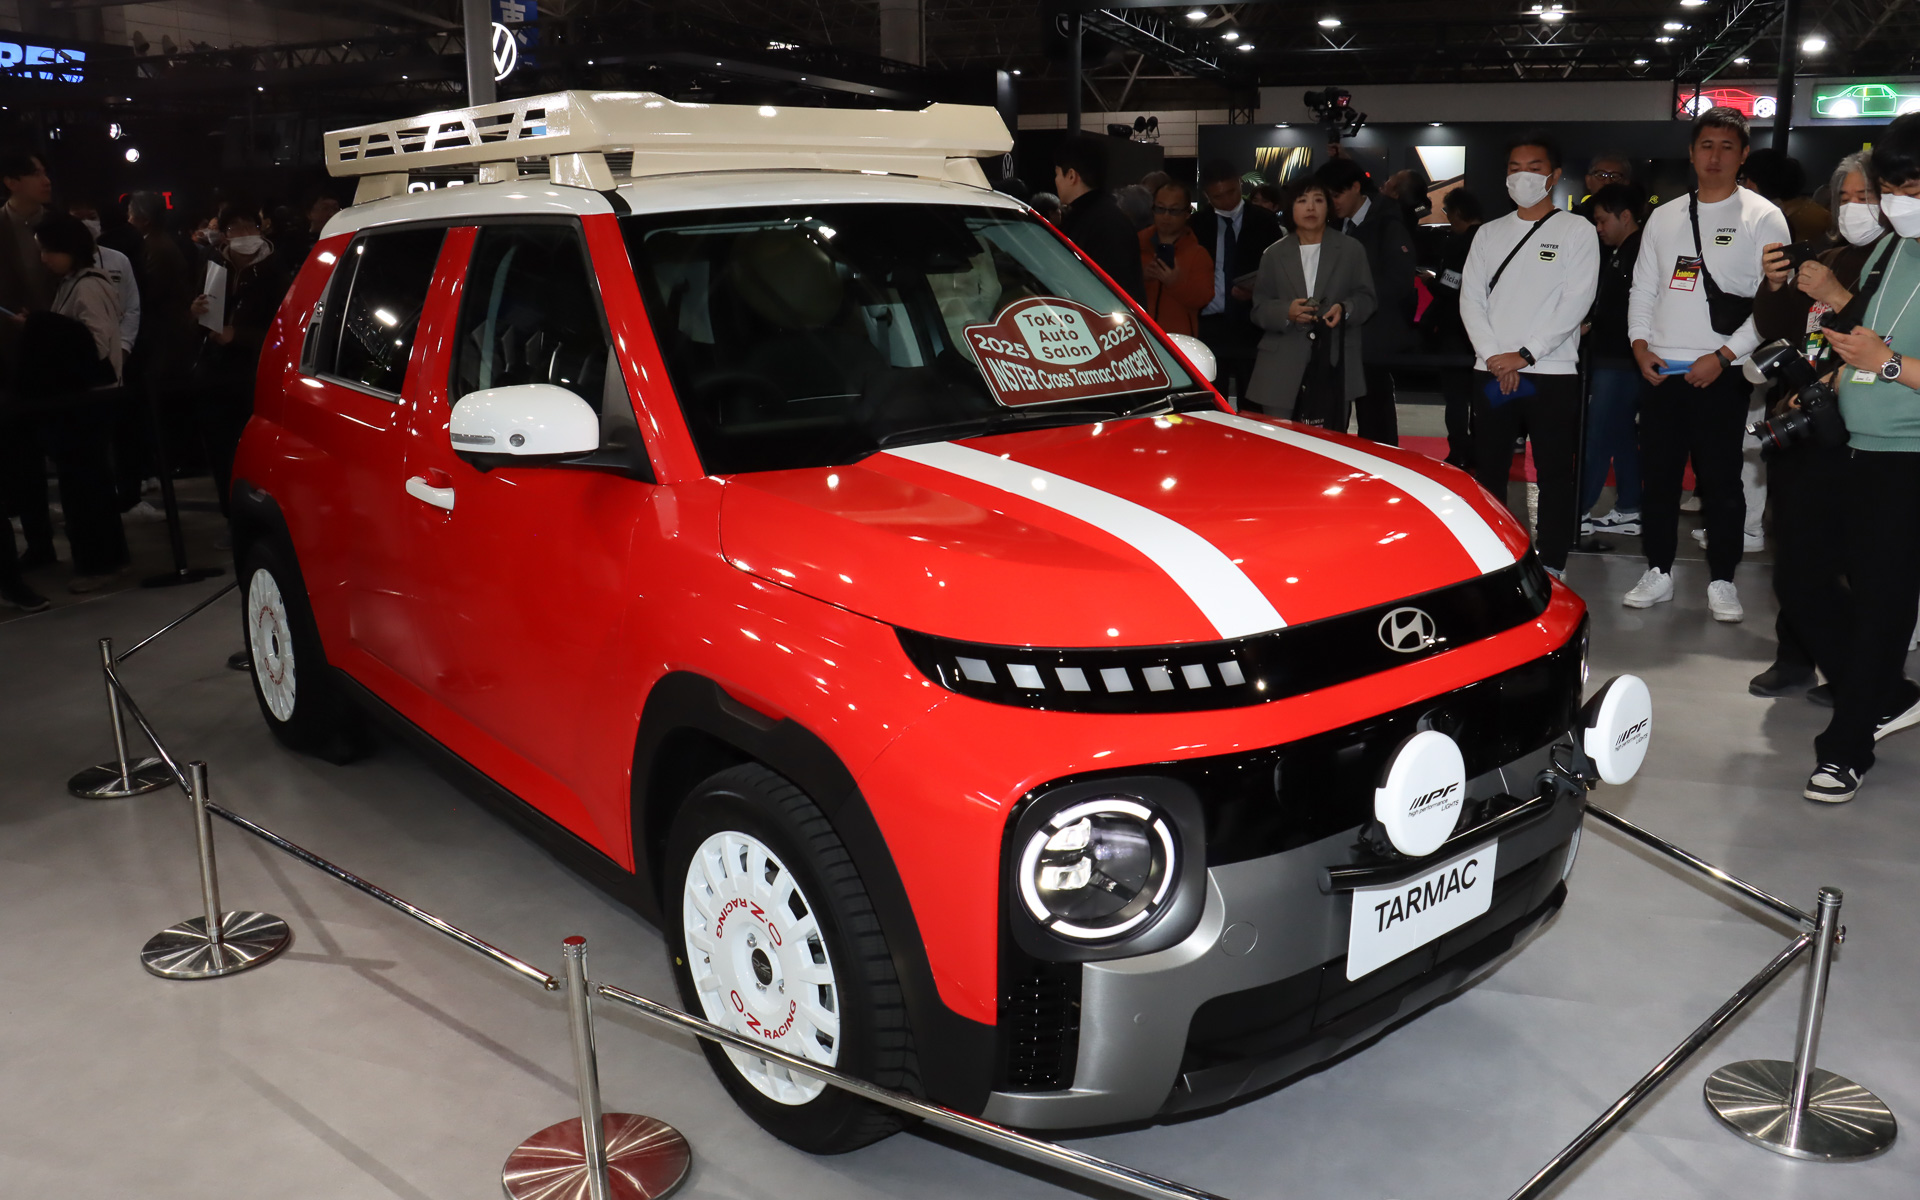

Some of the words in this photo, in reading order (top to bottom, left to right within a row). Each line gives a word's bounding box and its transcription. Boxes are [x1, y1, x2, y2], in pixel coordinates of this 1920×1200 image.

[1022, 312, 1075, 328] Tokyo
[974, 334, 1030, 359] 2025
[1039, 329, 1079, 343] Auto
[1099, 321, 1136, 351] 2025
[1042, 345, 1092, 360] Salon
[985, 357, 1043, 392] INSTER
[1037, 369, 1073, 389] Cross
[1068, 367, 1114, 386] Tarmac
[1110, 343, 1159, 381] Concept
[1419, 799, 1448, 814] performance
[1441, 800, 1459, 811] LIGHTS
[1374, 859, 1478, 933] TARMAC
[716, 898, 747, 939] RACING
[764, 999, 797, 1039] RACING
